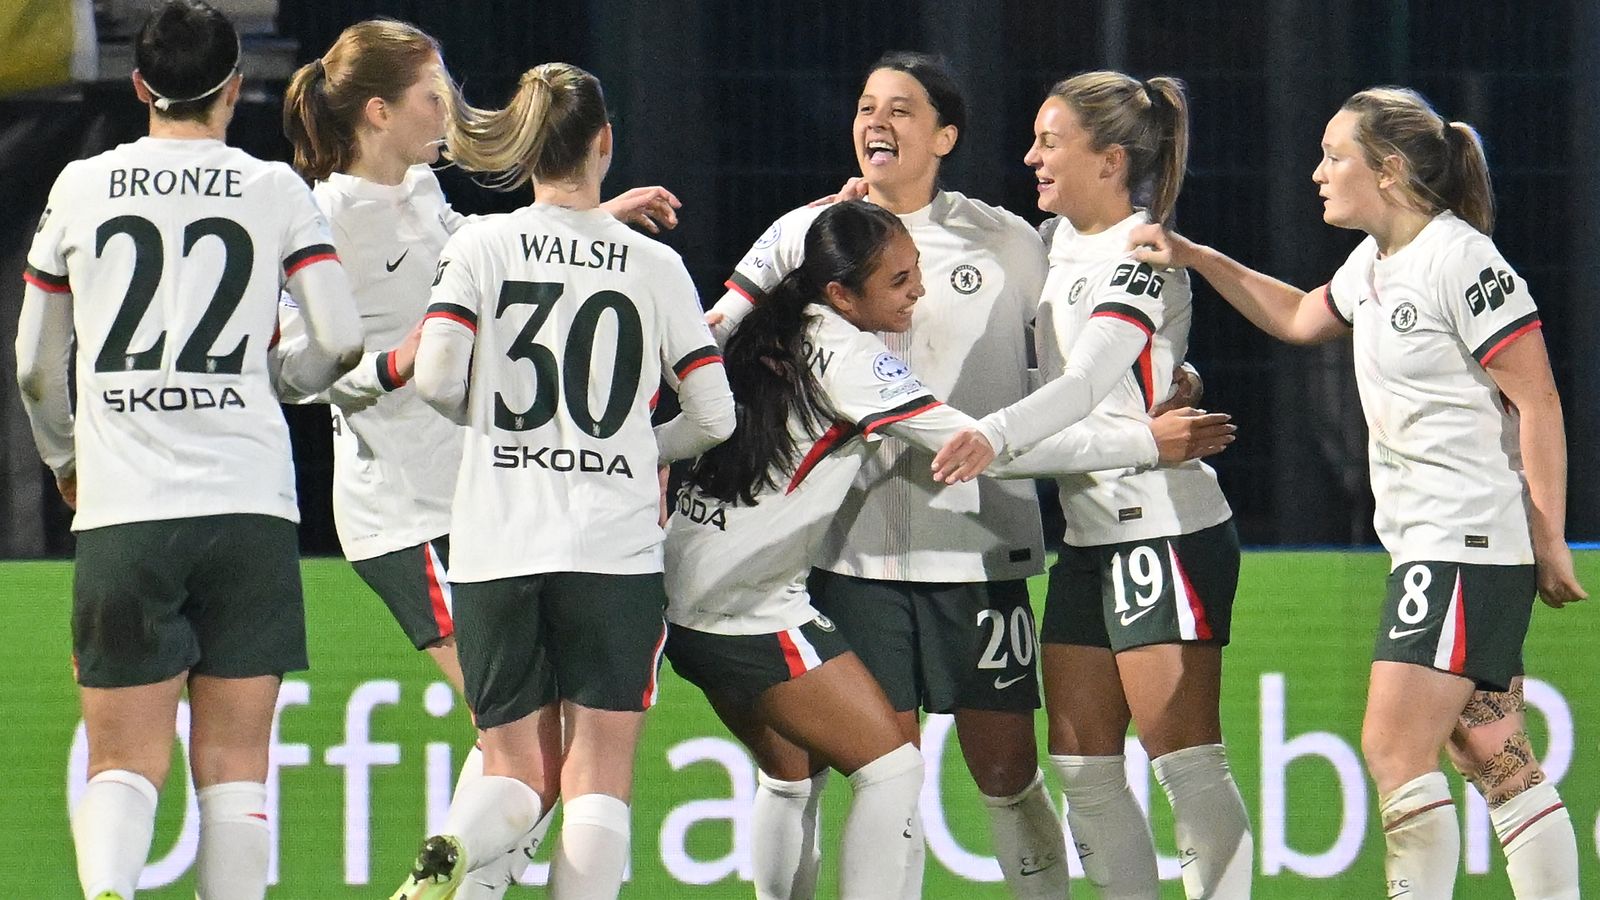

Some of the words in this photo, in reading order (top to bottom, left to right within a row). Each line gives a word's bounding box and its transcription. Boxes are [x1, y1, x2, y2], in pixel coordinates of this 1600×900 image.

[109, 167, 243, 199] BRONZE
[520, 233, 629, 273] WALSH
[95, 215, 255, 375] 22
[1110, 265, 1163, 296] FPT
[1467, 269, 1516, 313] FPT
[494, 280, 644, 439] 30
[679, 492, 726, 531] ODA
[1112, 545, 1164, 614] 19
[1397, 564, 1432, 624] 8
[976, 605, 1033, 669] 20
